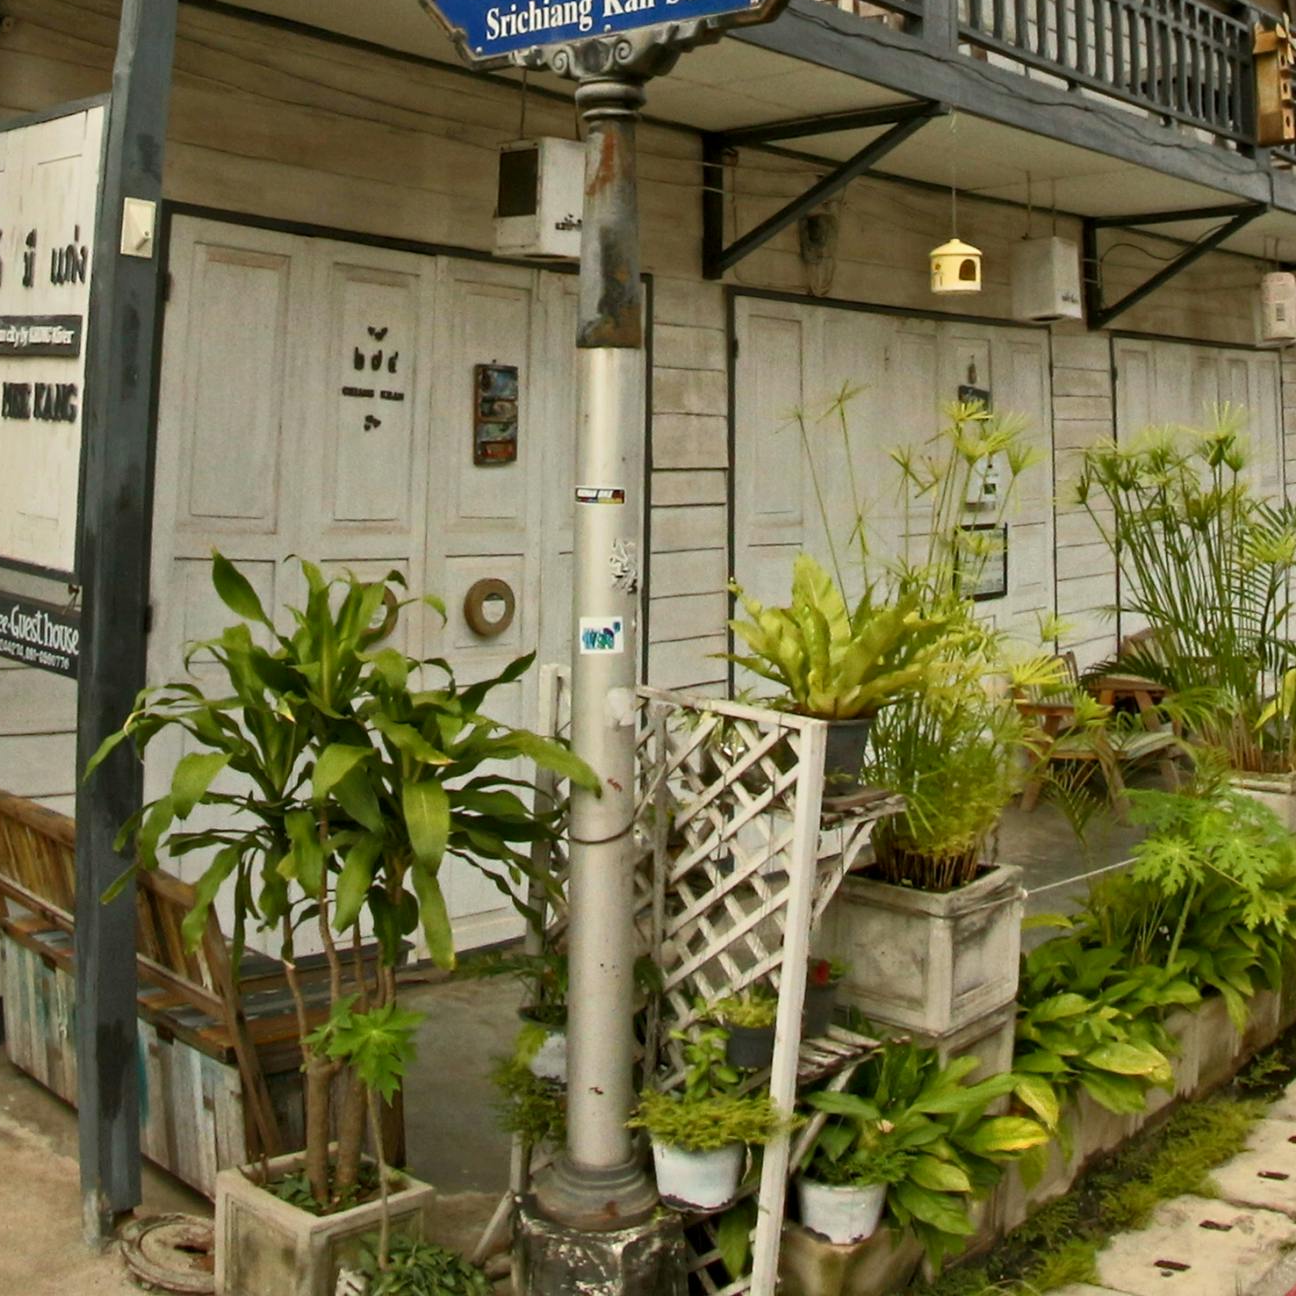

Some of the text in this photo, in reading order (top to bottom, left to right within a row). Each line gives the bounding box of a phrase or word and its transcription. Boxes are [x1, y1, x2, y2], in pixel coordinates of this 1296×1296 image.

[50, 223, 89, 286] แก่ง
[33, 382, 78, 423] KANG
[44, 612, 80, 655] house
